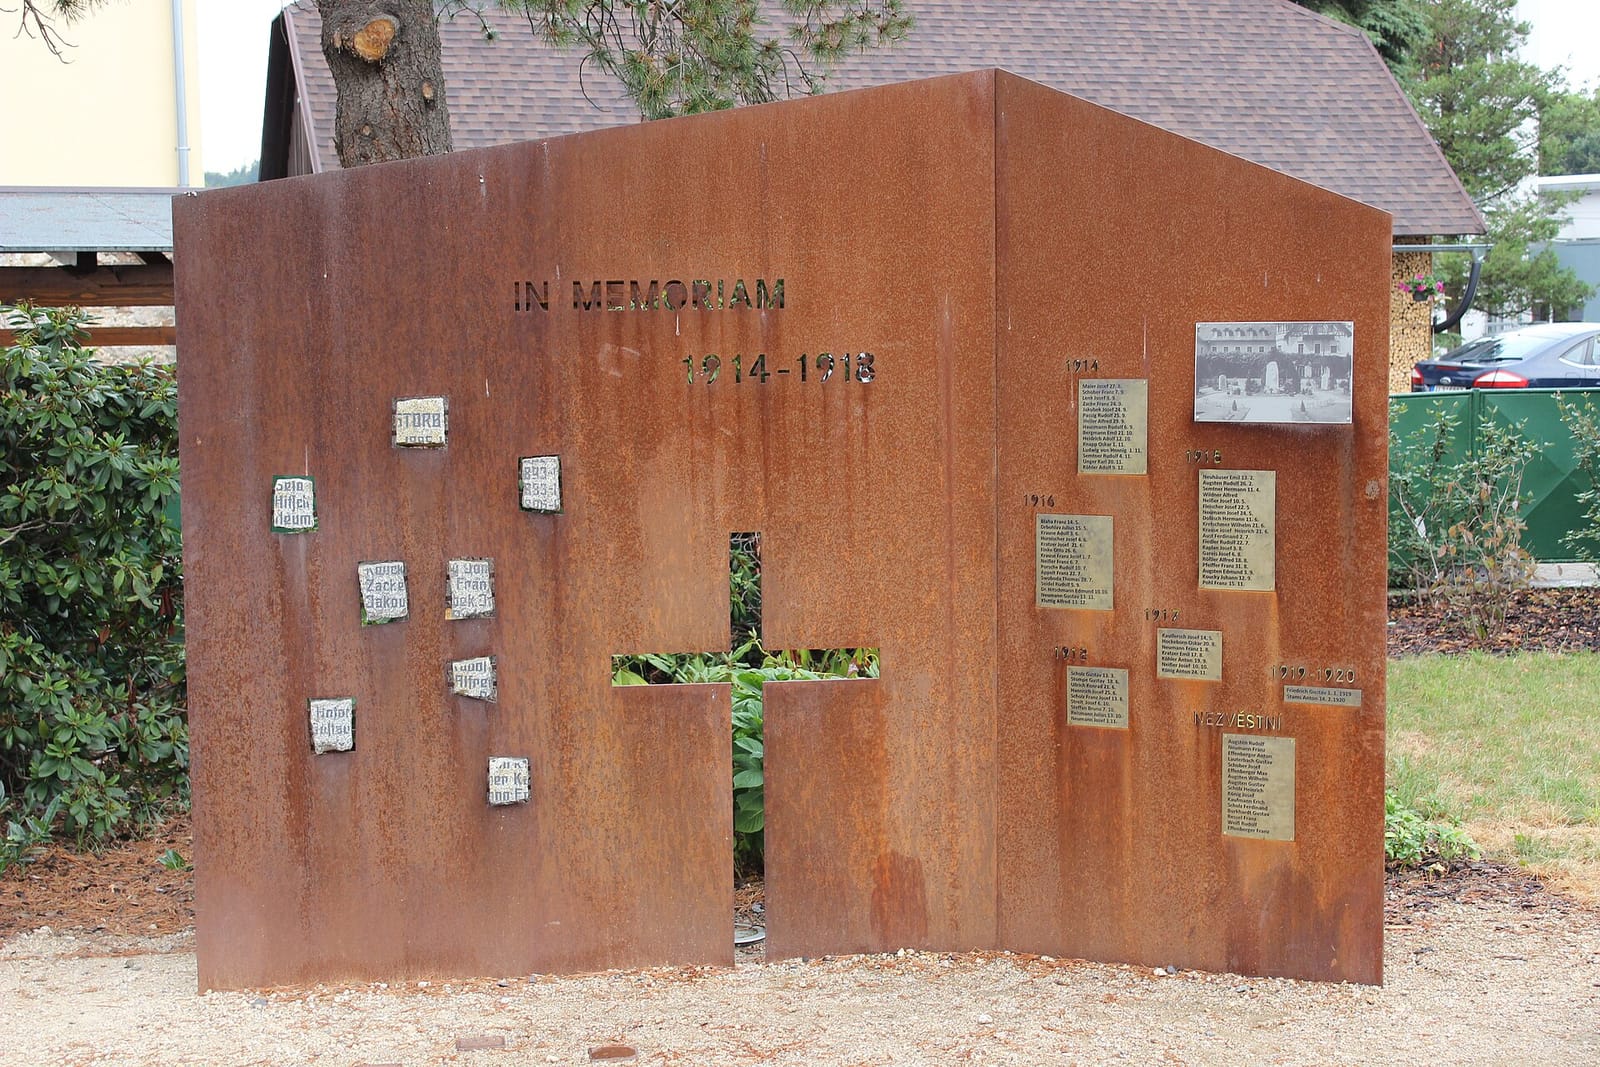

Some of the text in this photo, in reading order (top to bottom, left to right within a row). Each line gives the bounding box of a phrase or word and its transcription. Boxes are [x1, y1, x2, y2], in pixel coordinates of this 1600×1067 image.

[514, 278, 785, 311] IN MEMORIAM
[682, 352, 876, 384] 1914-1918
[1065, 359, 1099, 373] 1914
[1023, 494, 1055, 508] 1916
[1144, 607, 1181, 622] 1917
